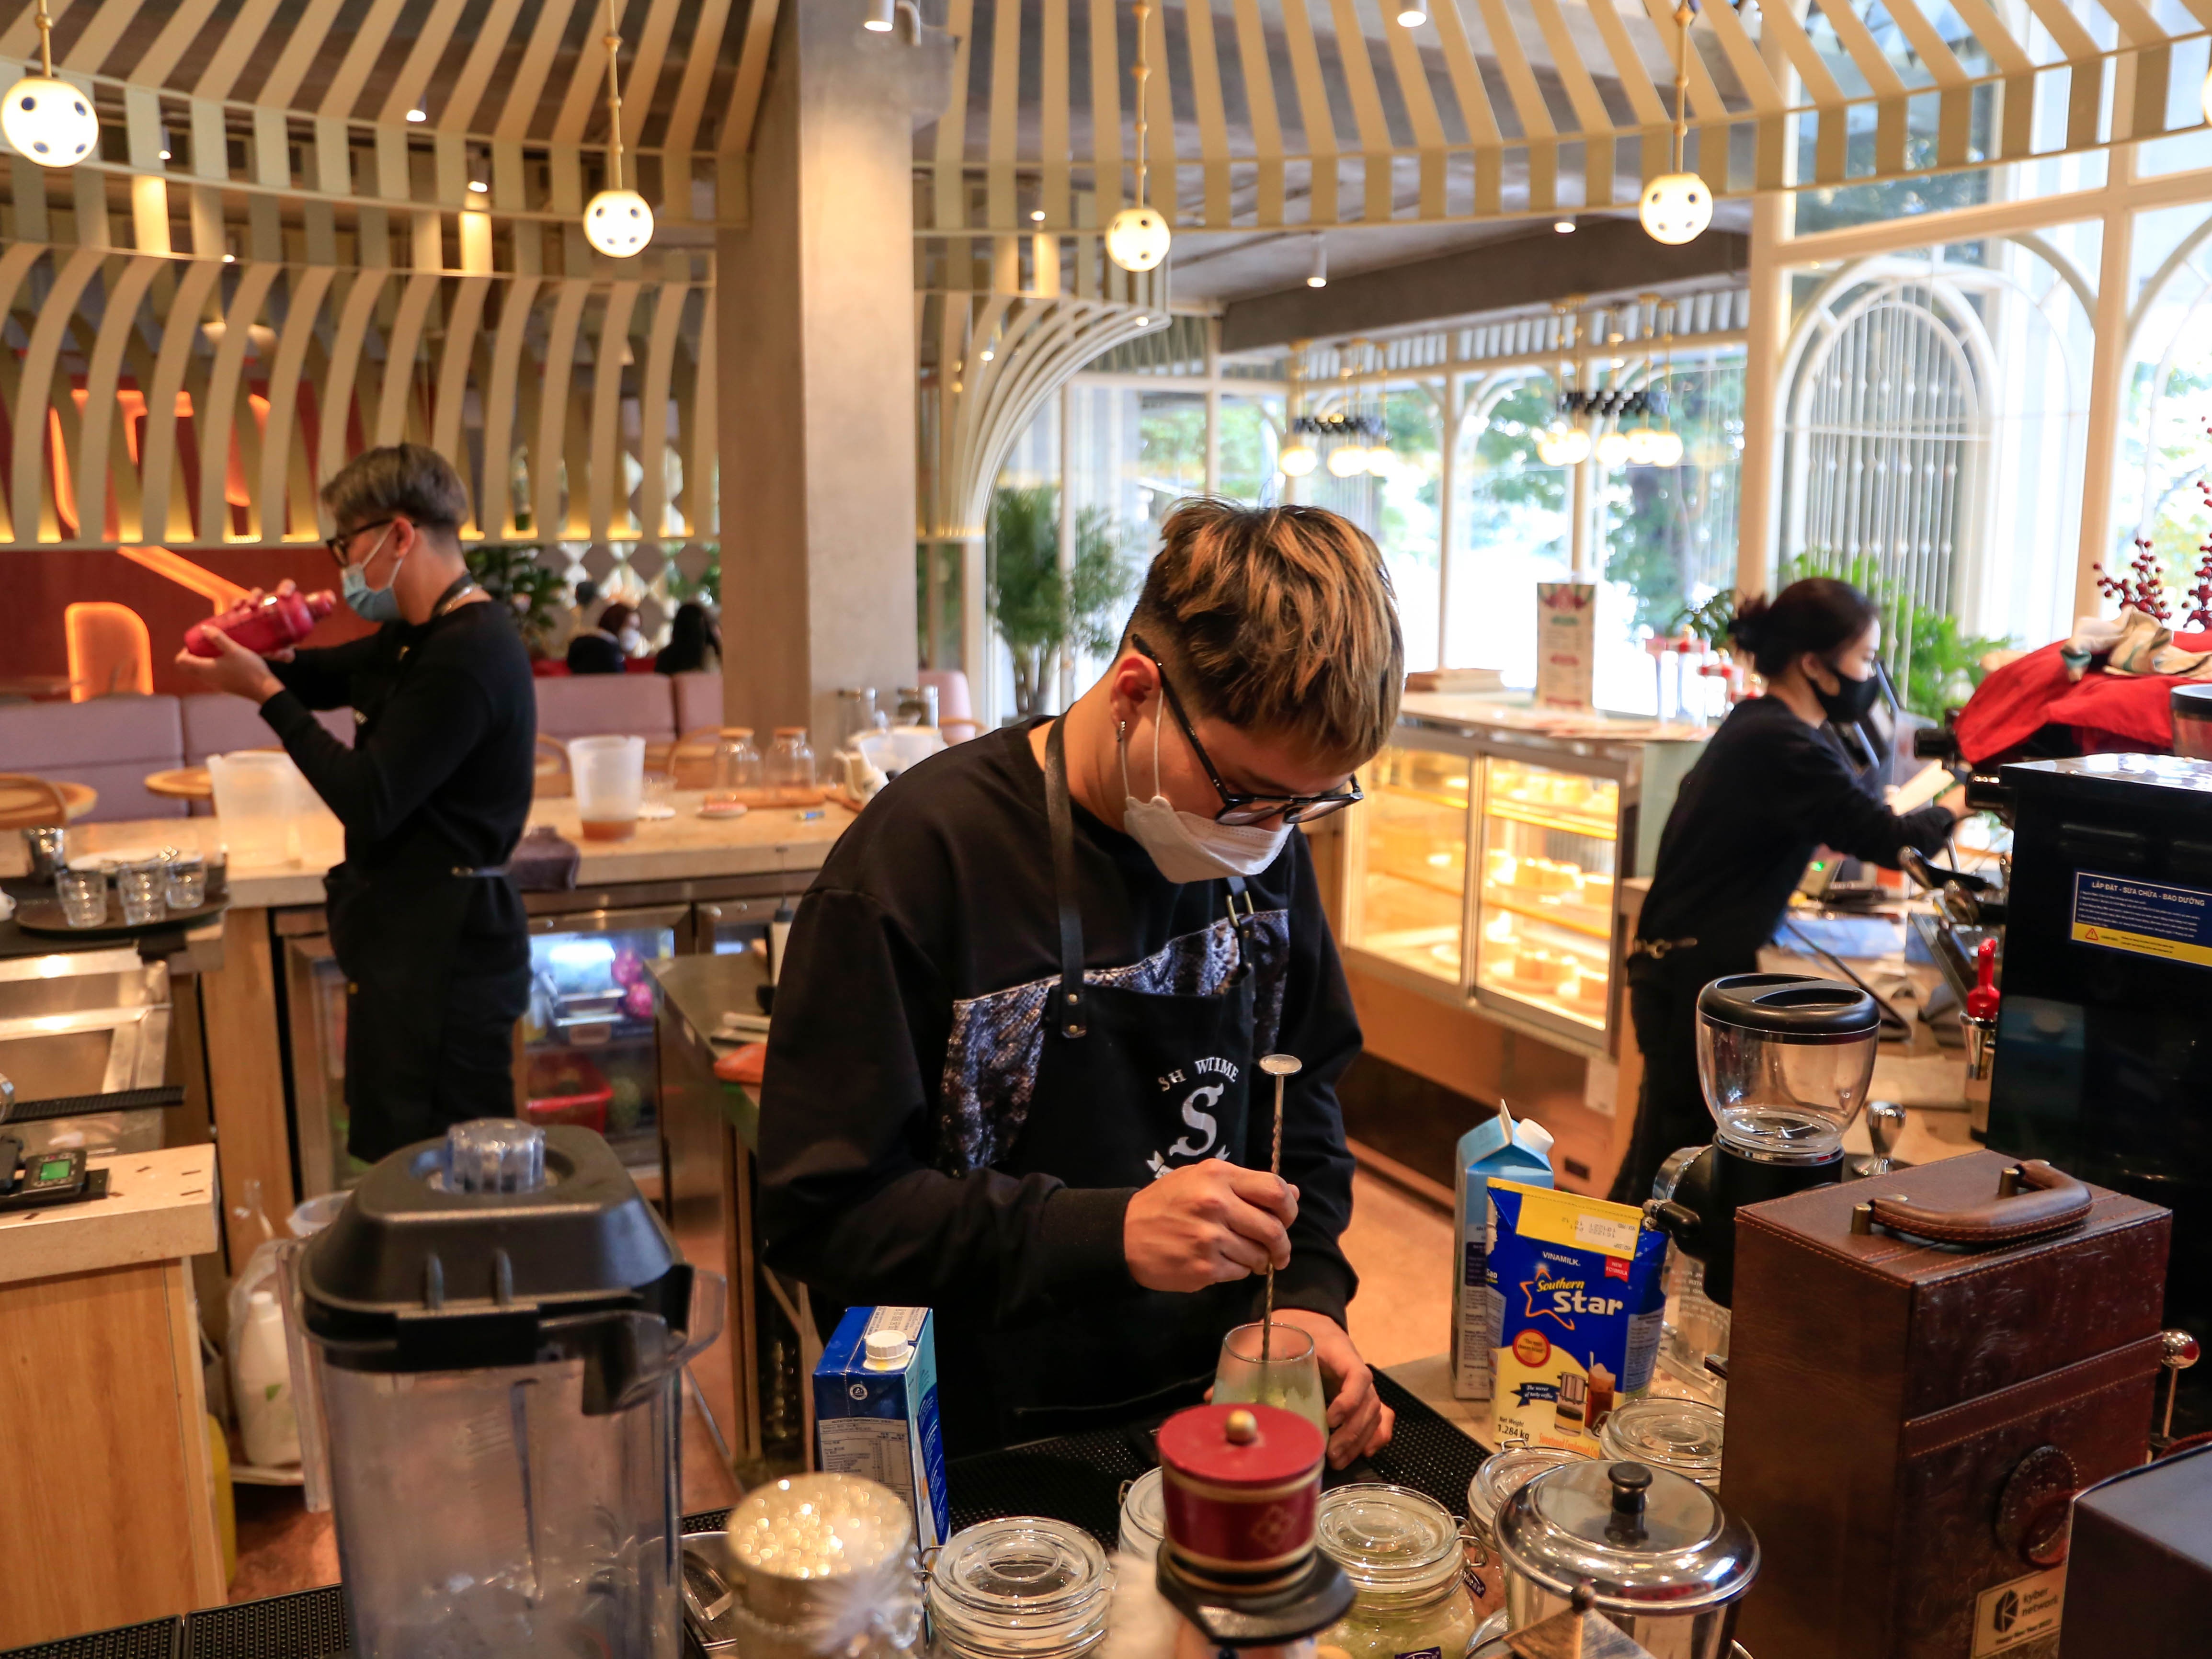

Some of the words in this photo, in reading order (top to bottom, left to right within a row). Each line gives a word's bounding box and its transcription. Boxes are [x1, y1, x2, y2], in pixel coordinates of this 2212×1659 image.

[1169, 1083, 1225, 1157] S
[1542, 1250, 1579, 1266] VINAMILK
[1536, 1277, 1585, 1292] Southern
[1553, 1290, 1624, 1316] Star
[1508, 1417, 1524, 1427] Weight
[1497, 1423, 1518, 1437] 1.284
[1519, 1430, 1529, 1442] kg
